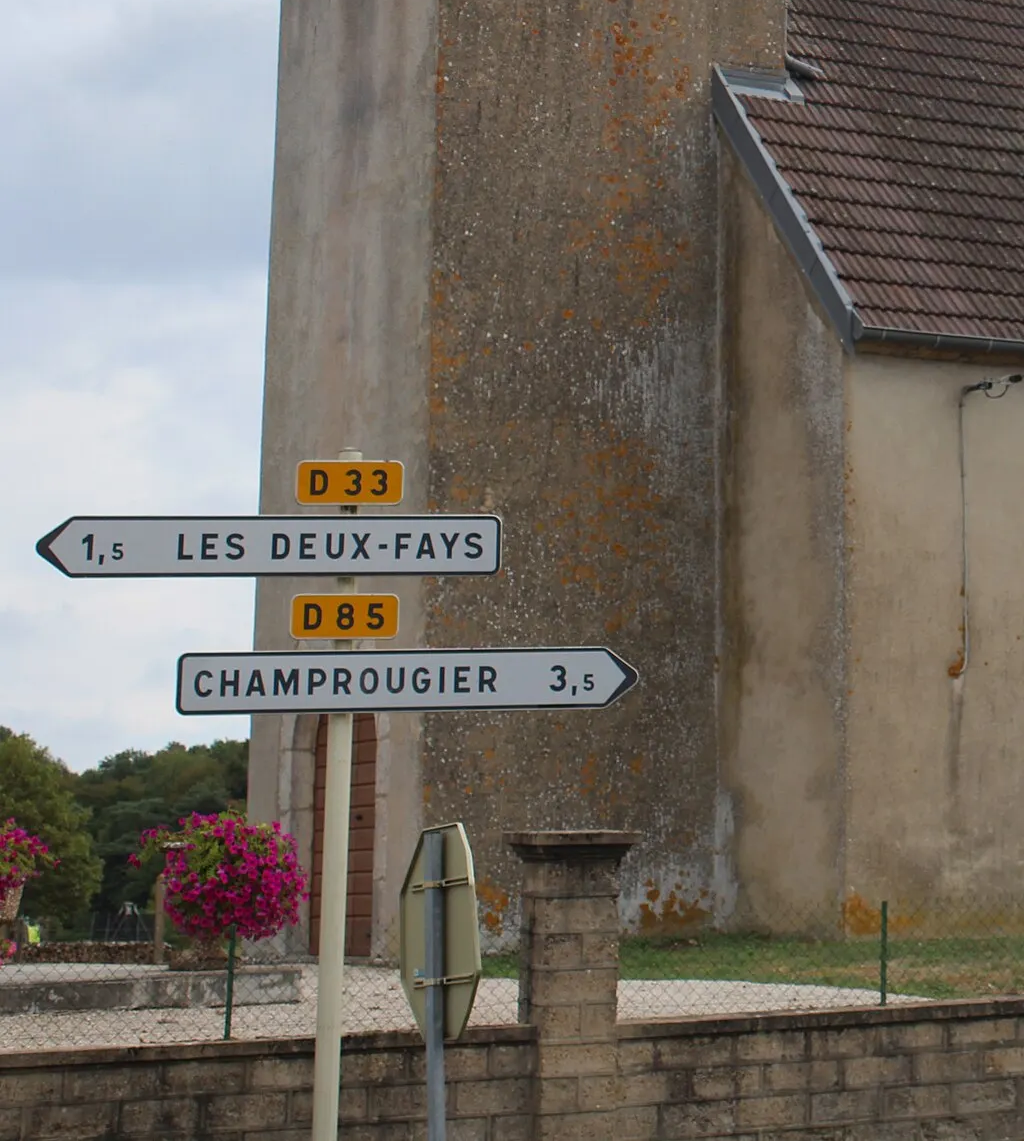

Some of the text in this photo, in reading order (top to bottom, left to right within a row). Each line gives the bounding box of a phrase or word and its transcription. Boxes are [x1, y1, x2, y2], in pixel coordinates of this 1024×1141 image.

[308, 468, 389, 497] D 33
[81, 532, 485, 566] 1,5 LES DEUX-FAYS
[193, 664, 595, 698] CHAMPROUGIER 3,5
